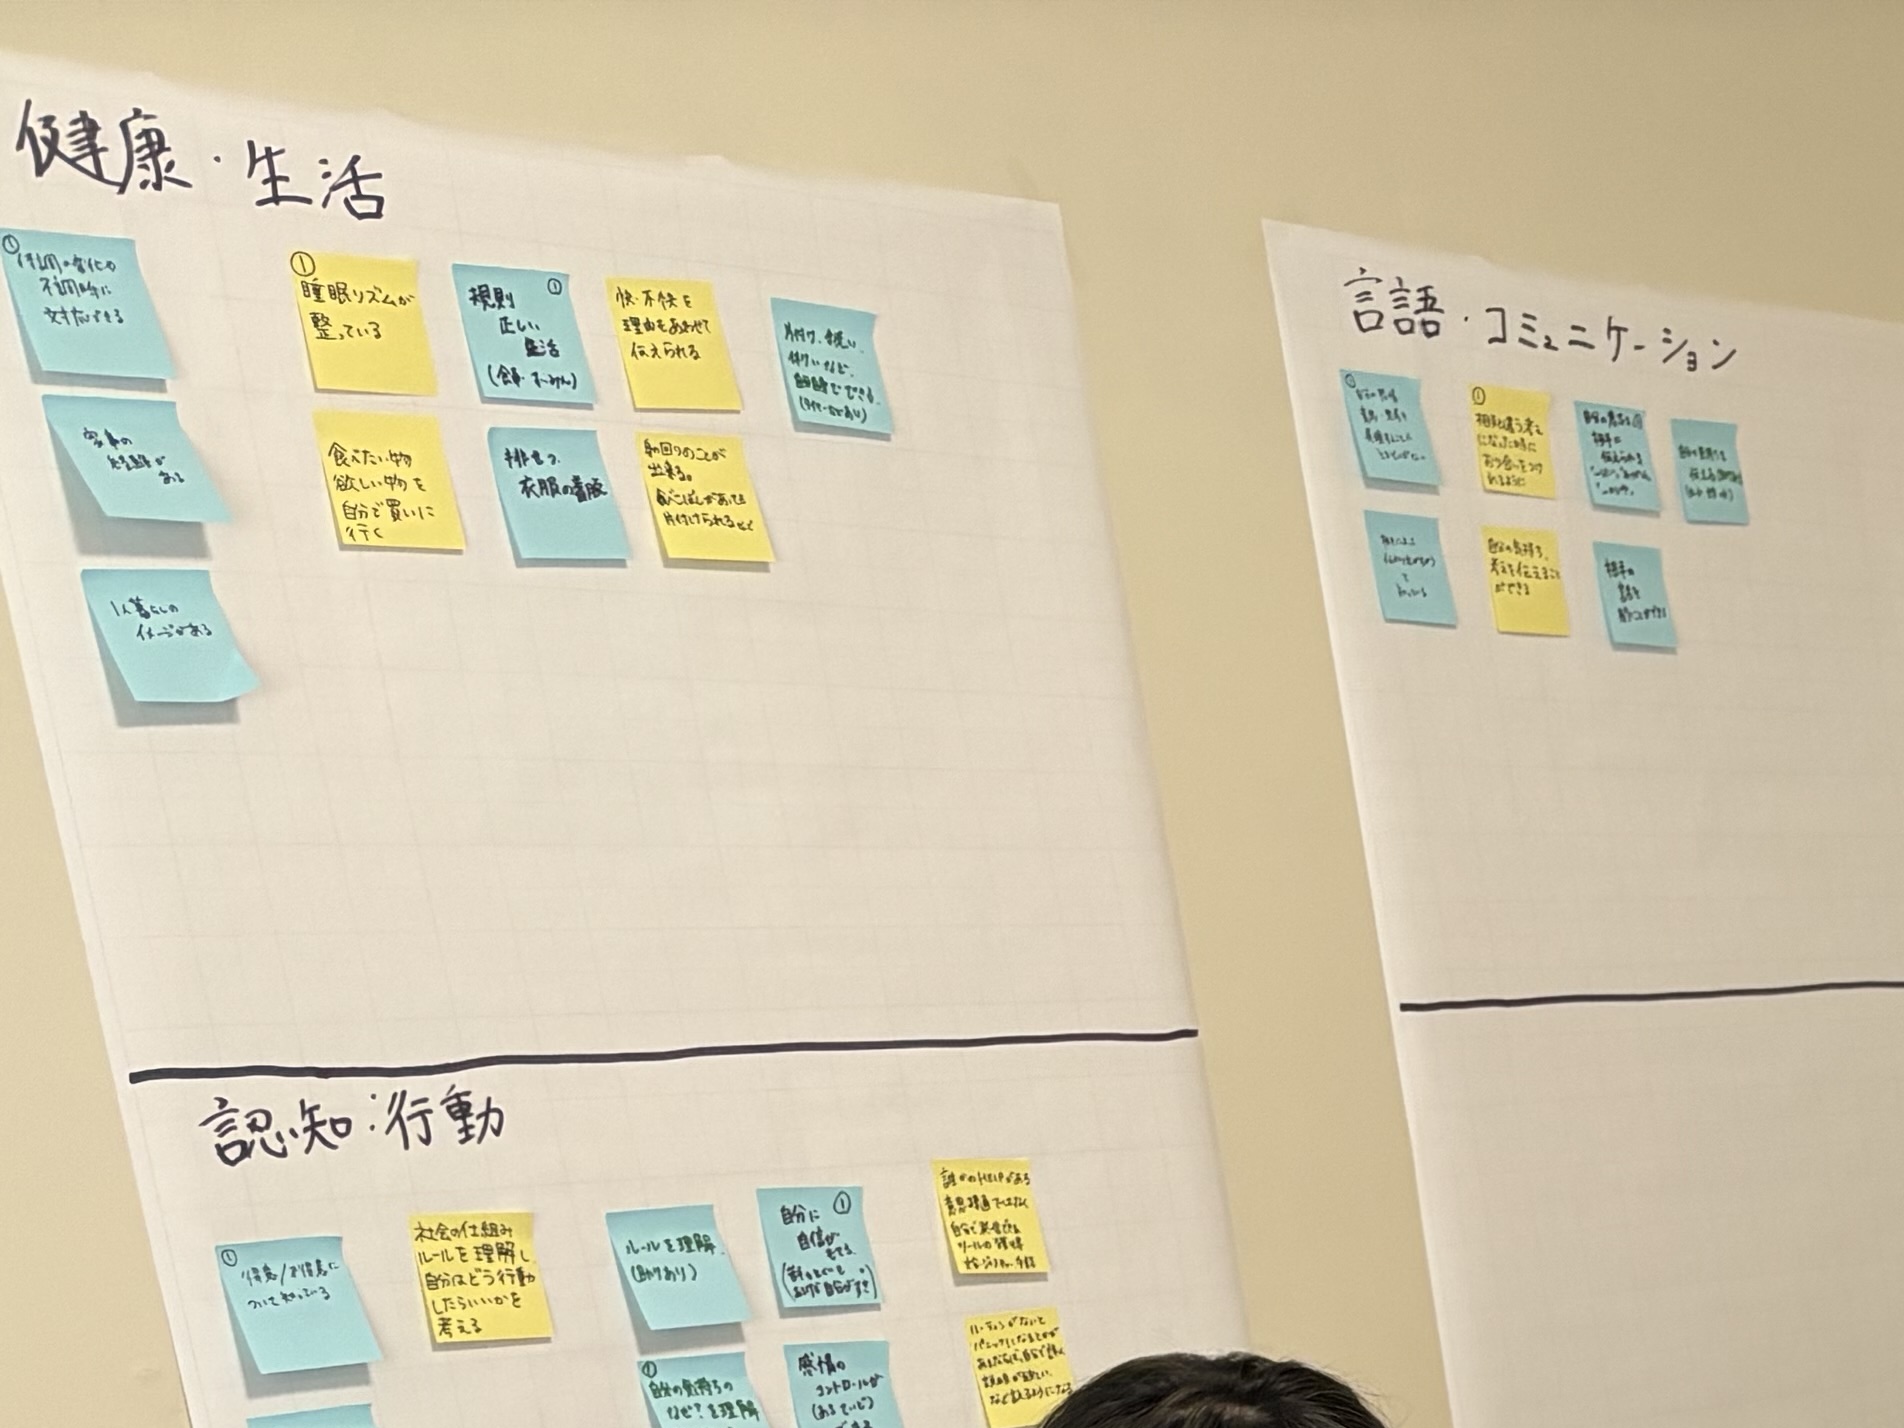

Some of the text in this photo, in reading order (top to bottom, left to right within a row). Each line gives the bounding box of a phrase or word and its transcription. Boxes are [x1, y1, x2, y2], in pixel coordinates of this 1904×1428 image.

[300, 278, 416, 308] 睡眠リズムが
[468, 283, 516, 312] 規則
[309, 311, 383, 341] 整っている
[499, 315, 541, 335] 正しい
[1343, 266, 1739, 373] 言語・コミュニケーション
[630, 341, 702, 362] 伝えられる
[327, 441, 413, 468] 食べたい物
[332, 473, 428, 494] 欲しい物を
[341, 498, 436, 523] 自分で買いに
[345, 523, 385, 542] 行く
[780, 1203, 821, 1226] 自分に
[413, 1219, 514, 1243] 社会の仕組み
[424, 1265, 537, 1292] 自分はどう行動
[430, 1291, 523, 1316] したらいいかを
[437, 1316, 483, 1340] 考える
